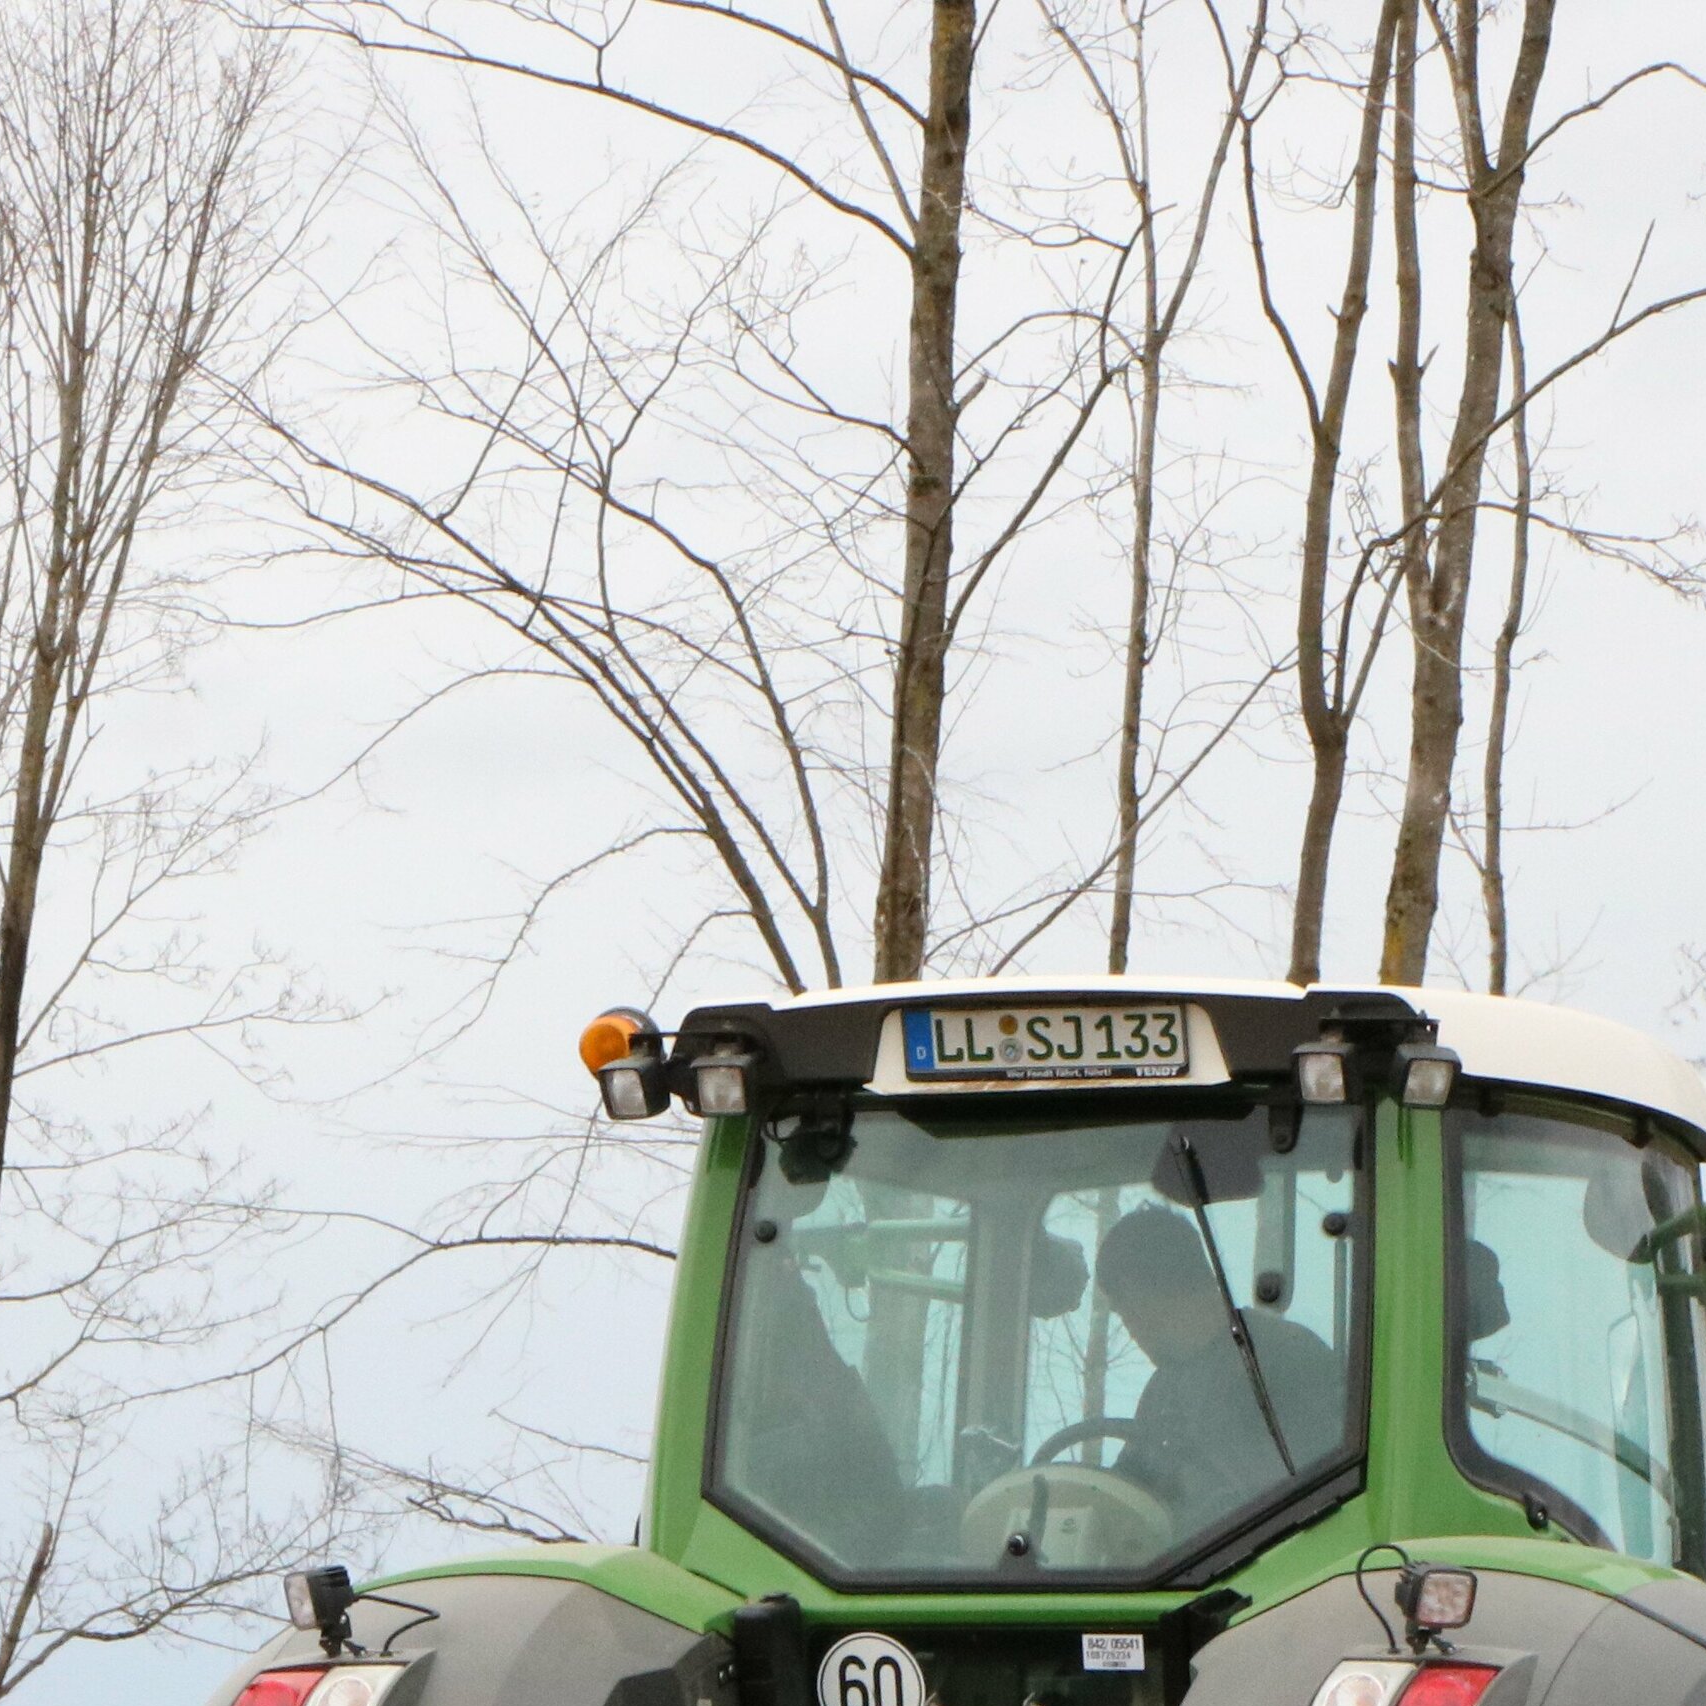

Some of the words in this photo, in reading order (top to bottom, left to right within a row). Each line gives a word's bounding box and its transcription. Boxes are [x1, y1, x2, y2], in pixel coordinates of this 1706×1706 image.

[935, 1017, 995, 1063] LL
[1025, 1015, 1085, 1061] SJ
[1094, 1012, 1179, 1059] 133
[916, 1048, 926, 1061] D
[1135, 1065, 1179, 1077] FENDT
